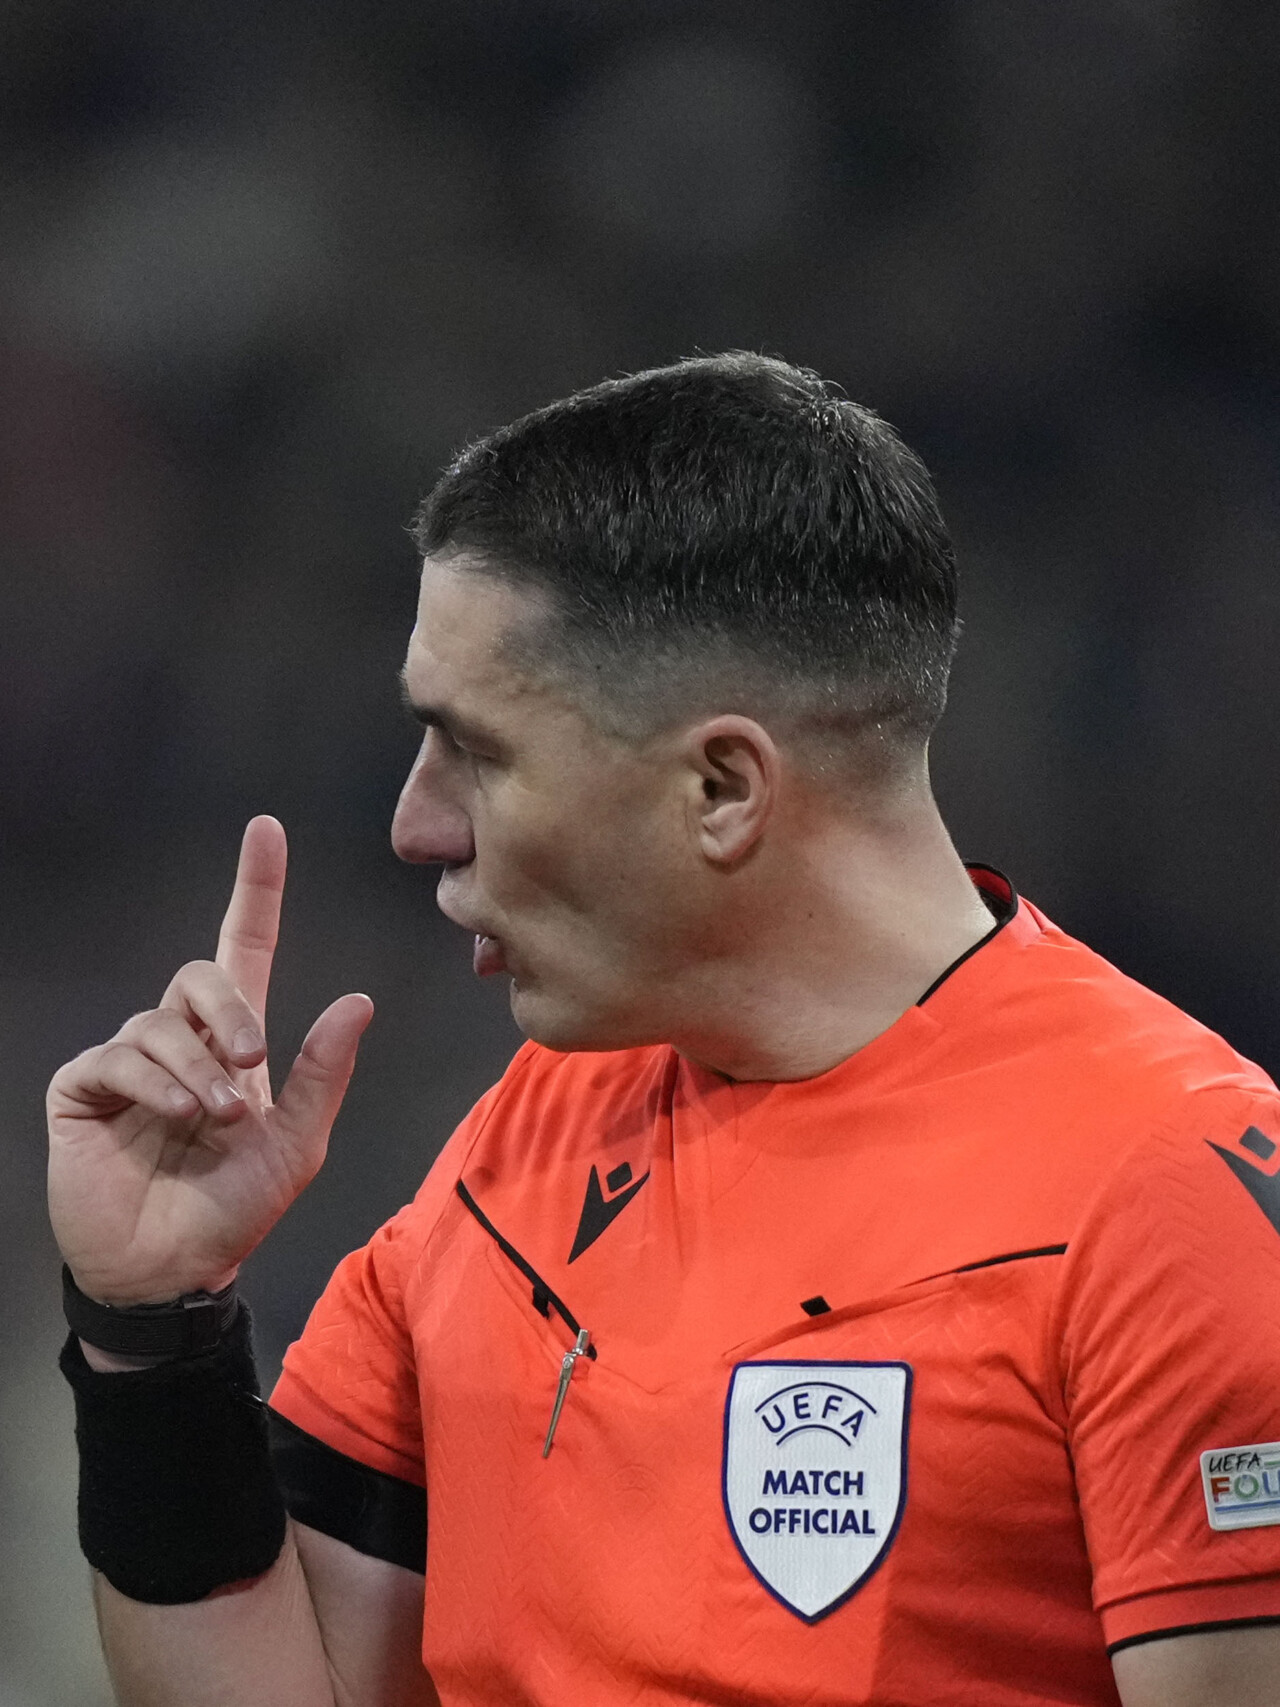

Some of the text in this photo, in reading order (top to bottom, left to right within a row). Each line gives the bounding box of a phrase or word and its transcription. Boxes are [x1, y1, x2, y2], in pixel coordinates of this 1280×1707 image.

[761, 1392, 865, 1438] UEFA
[1208, 1451, 1261, 1473] UEFA
[762, 1469, 864, 1496] MATCH
[749, 1507, 876, 1535] OFFICIAL
